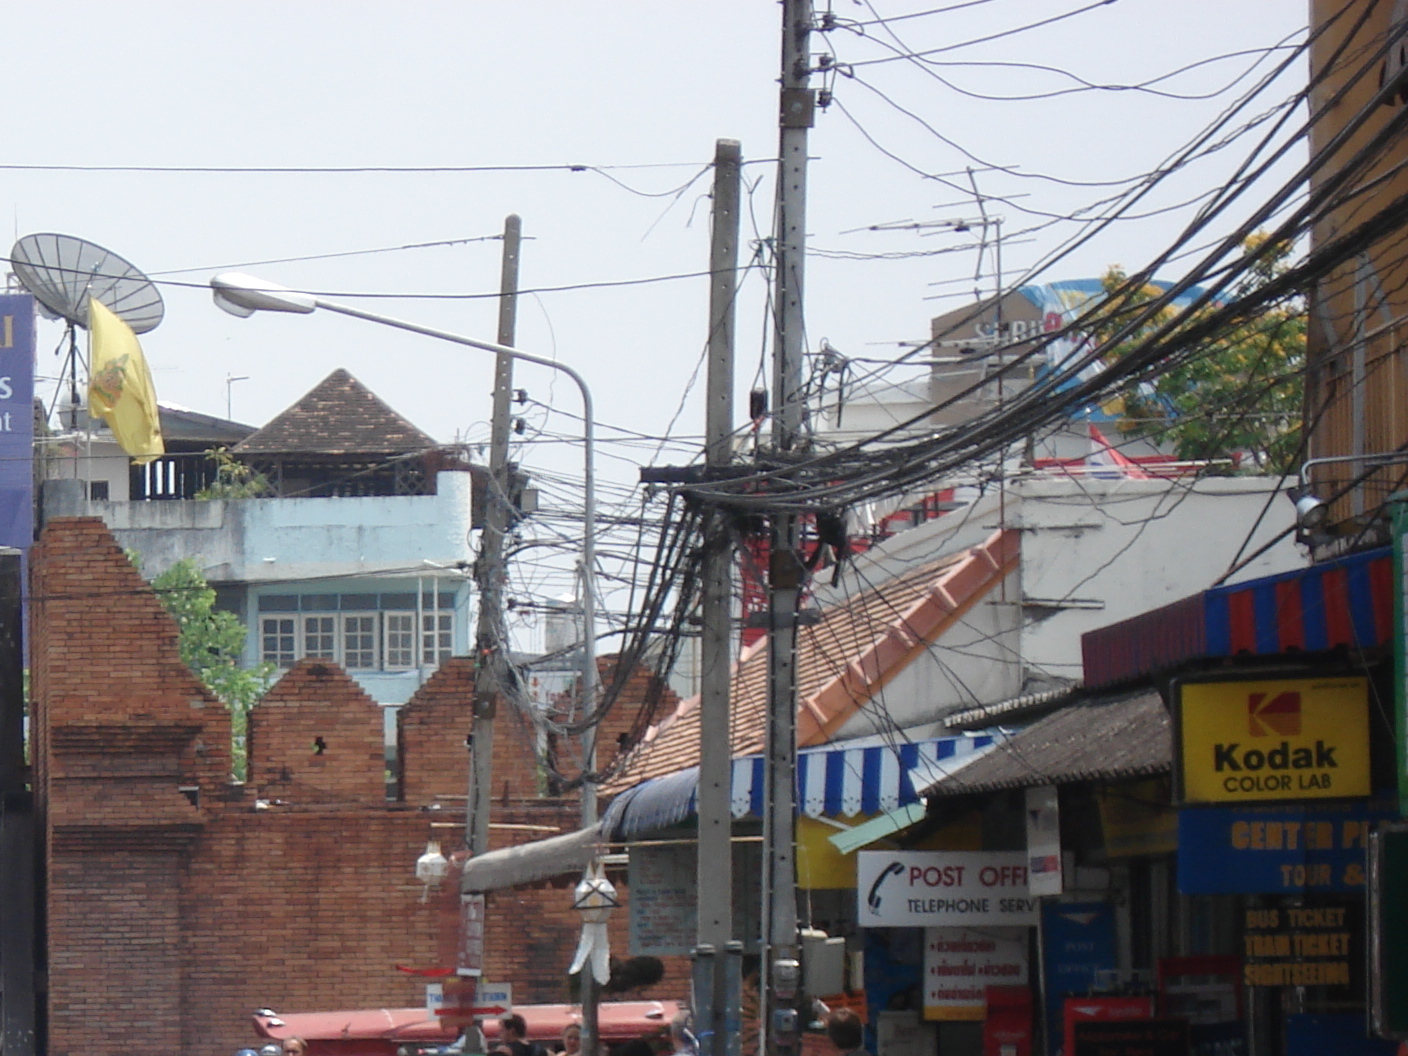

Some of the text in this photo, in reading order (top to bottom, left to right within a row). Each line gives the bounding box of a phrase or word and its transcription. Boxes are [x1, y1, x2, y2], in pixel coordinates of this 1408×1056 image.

[1214, 740, 1338, 772] Kodak
[1223, 773, 1332, 793] COLOR LAB
[1231, 820, 1334, 850] CENTER
[909, 866, 965, 887] POST
[1281, 863, 1367, 887] TOUR &
[908, 898, 1036, 913] TELEPHONE SERV
[1246, 907, 1345, 929] BUS TICKET
[1293, 933, 1350, 956] TICKET
[1244, 961, 1350, 986] SIGHTSEEING
